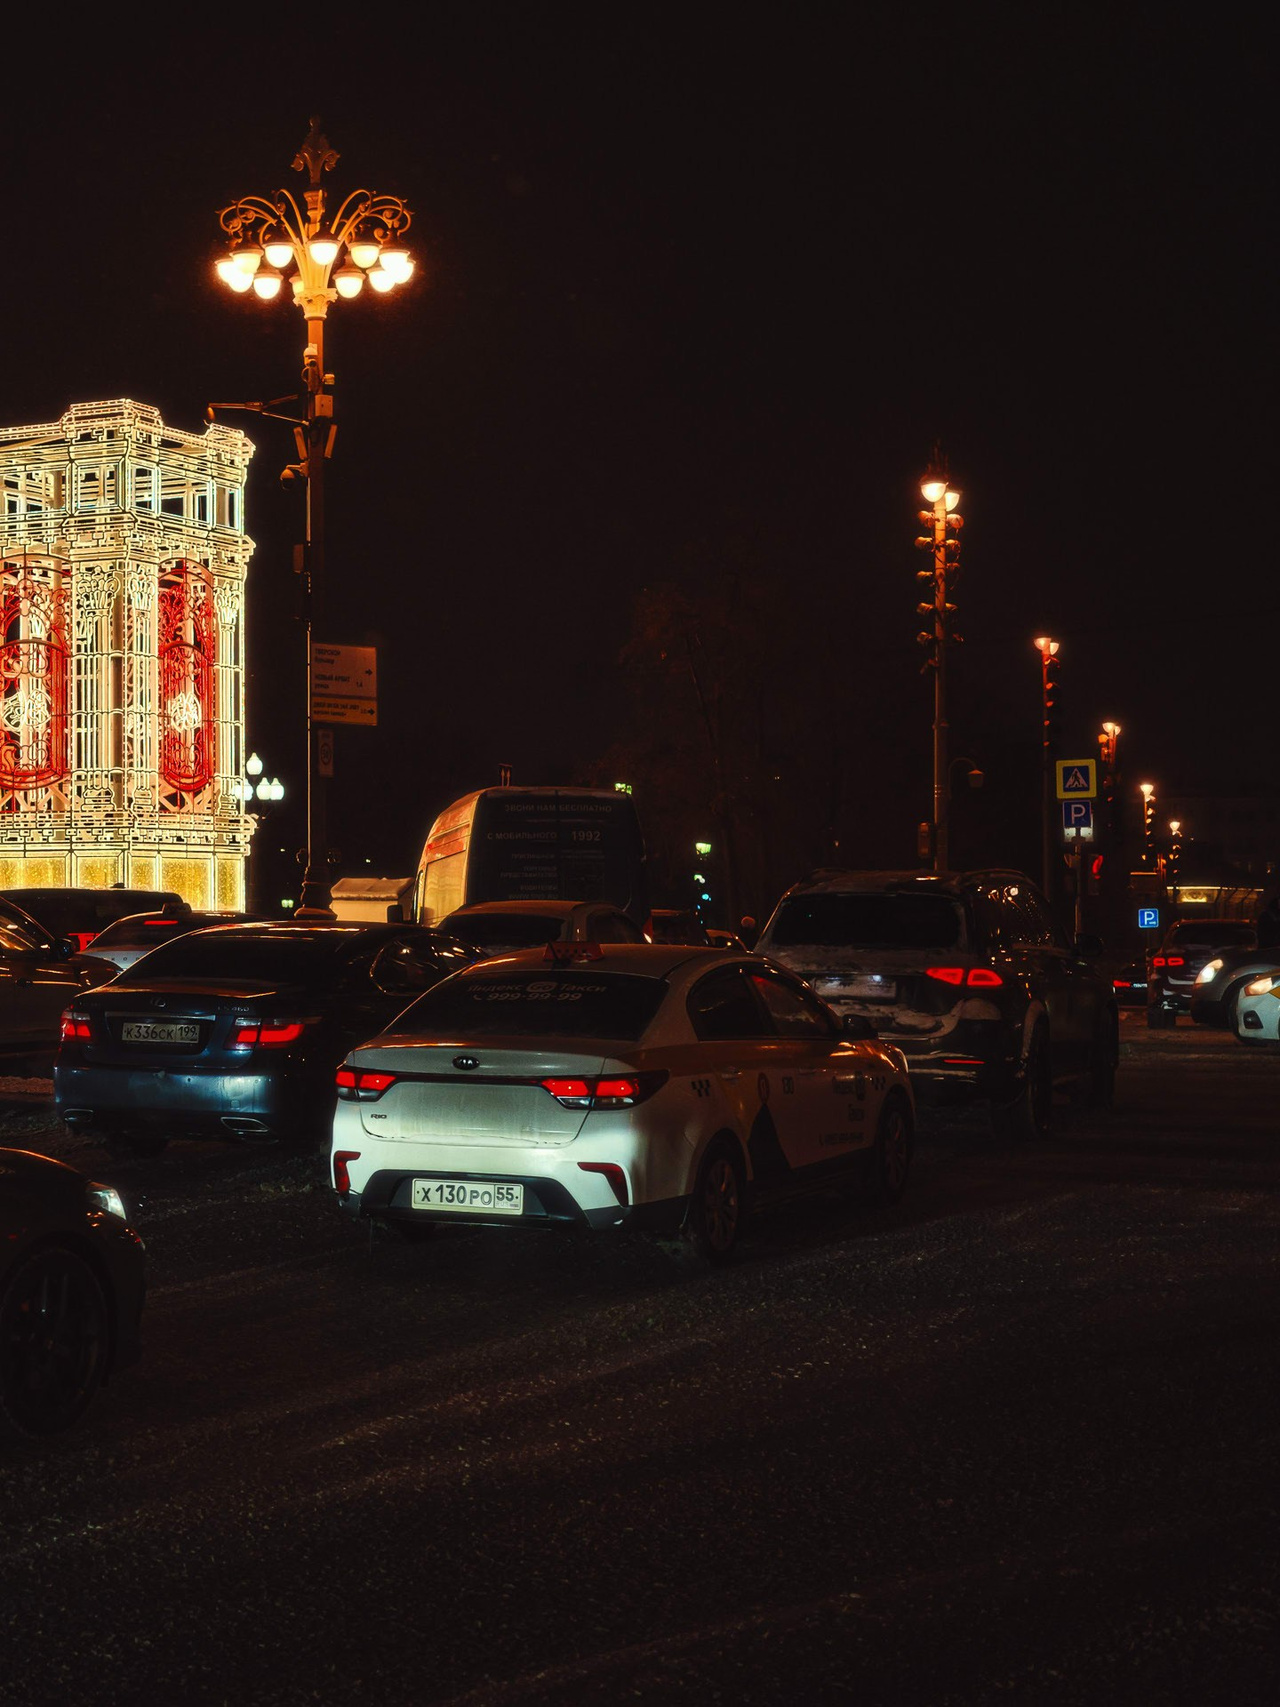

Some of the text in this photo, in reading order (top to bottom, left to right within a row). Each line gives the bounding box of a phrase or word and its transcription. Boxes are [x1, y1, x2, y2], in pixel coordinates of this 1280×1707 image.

[504, 804, 612, 813] ЗВОНИ НАМ БЕСПЛАТНО
[487, 830, 601, 841] С МОБИЛЬНОГО 1992
[467, 984, 524, 993] Яндекс
[561, 983, 607, 993] Такси
[486, 992, 582, 1001] 999-99-99
[178, 1026, 196, 1037] 199
[496, 1187, 514, 1201] 55
